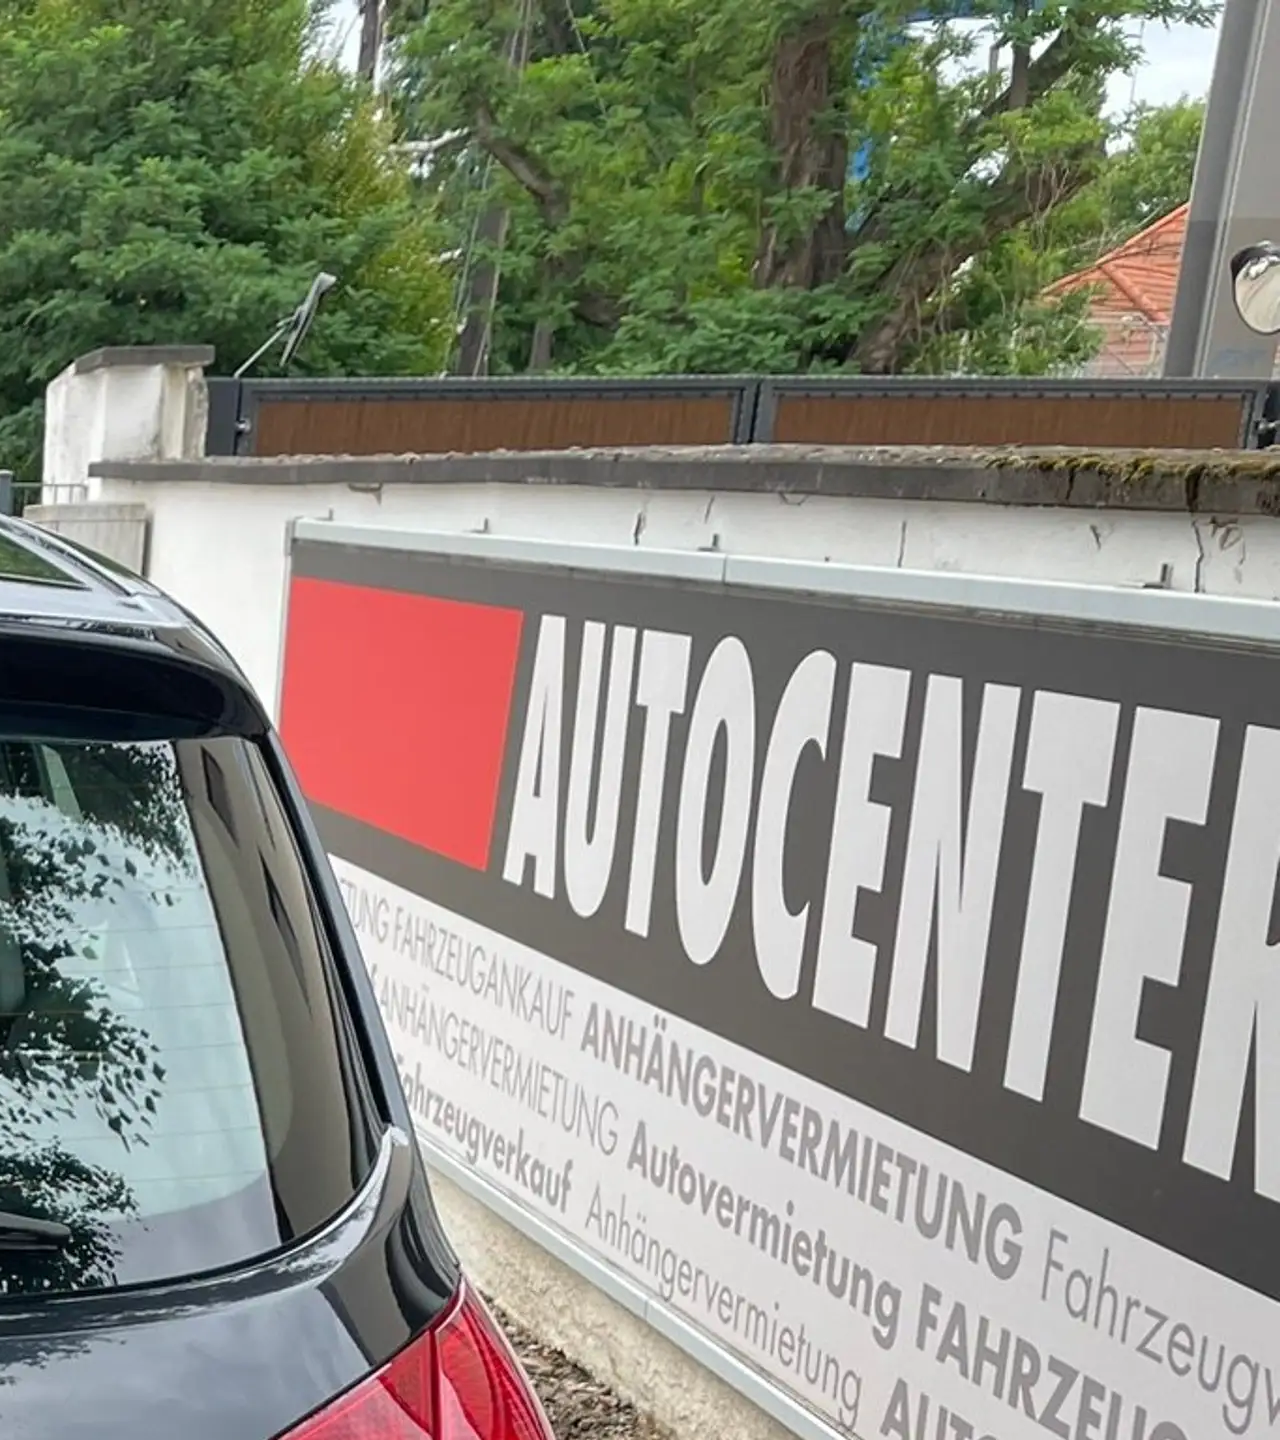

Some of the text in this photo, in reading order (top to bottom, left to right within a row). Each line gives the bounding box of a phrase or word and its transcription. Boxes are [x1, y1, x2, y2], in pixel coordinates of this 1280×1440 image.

[392, 906, 575, 1042] FAHRZEUGANKAUF
[580, 1002, 1023, 1281] ANHÄNGERVERMIETUNG
[501, 614, 1280, 1203] AUTOCENTER
[380, 973, 620, 1156] ANHÄNGERVERMIETUNG
[626, 1120, 903, 1351] Autovermietung
[584, 1185, 864, 1430] Anhängervermietung
